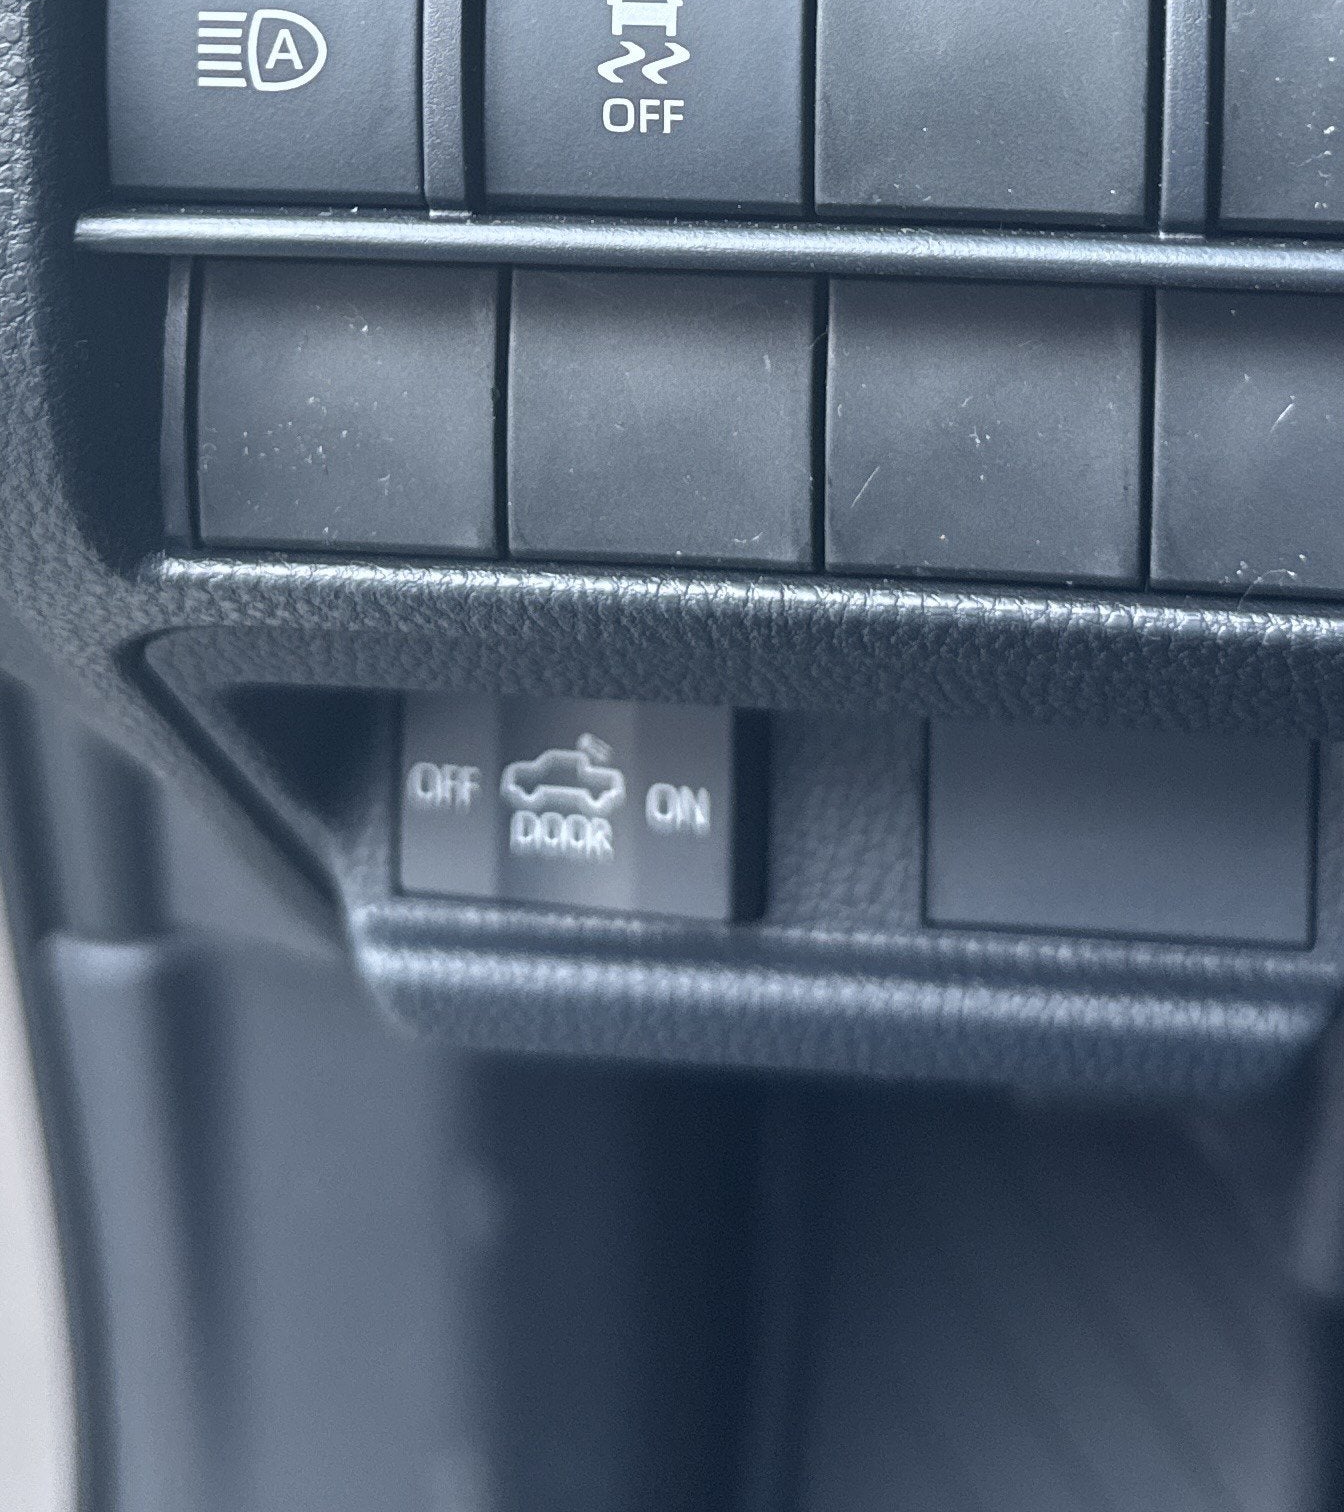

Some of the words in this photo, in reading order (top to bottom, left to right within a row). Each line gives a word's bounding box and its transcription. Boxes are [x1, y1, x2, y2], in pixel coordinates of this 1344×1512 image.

[264, 28, 305, 70] A
[602, 97, 685, 134] OFF
[407, 762, 480, 809] OFF
[645, 783, 711, 835] ON
[510, 810, 615, 860] DOOR
